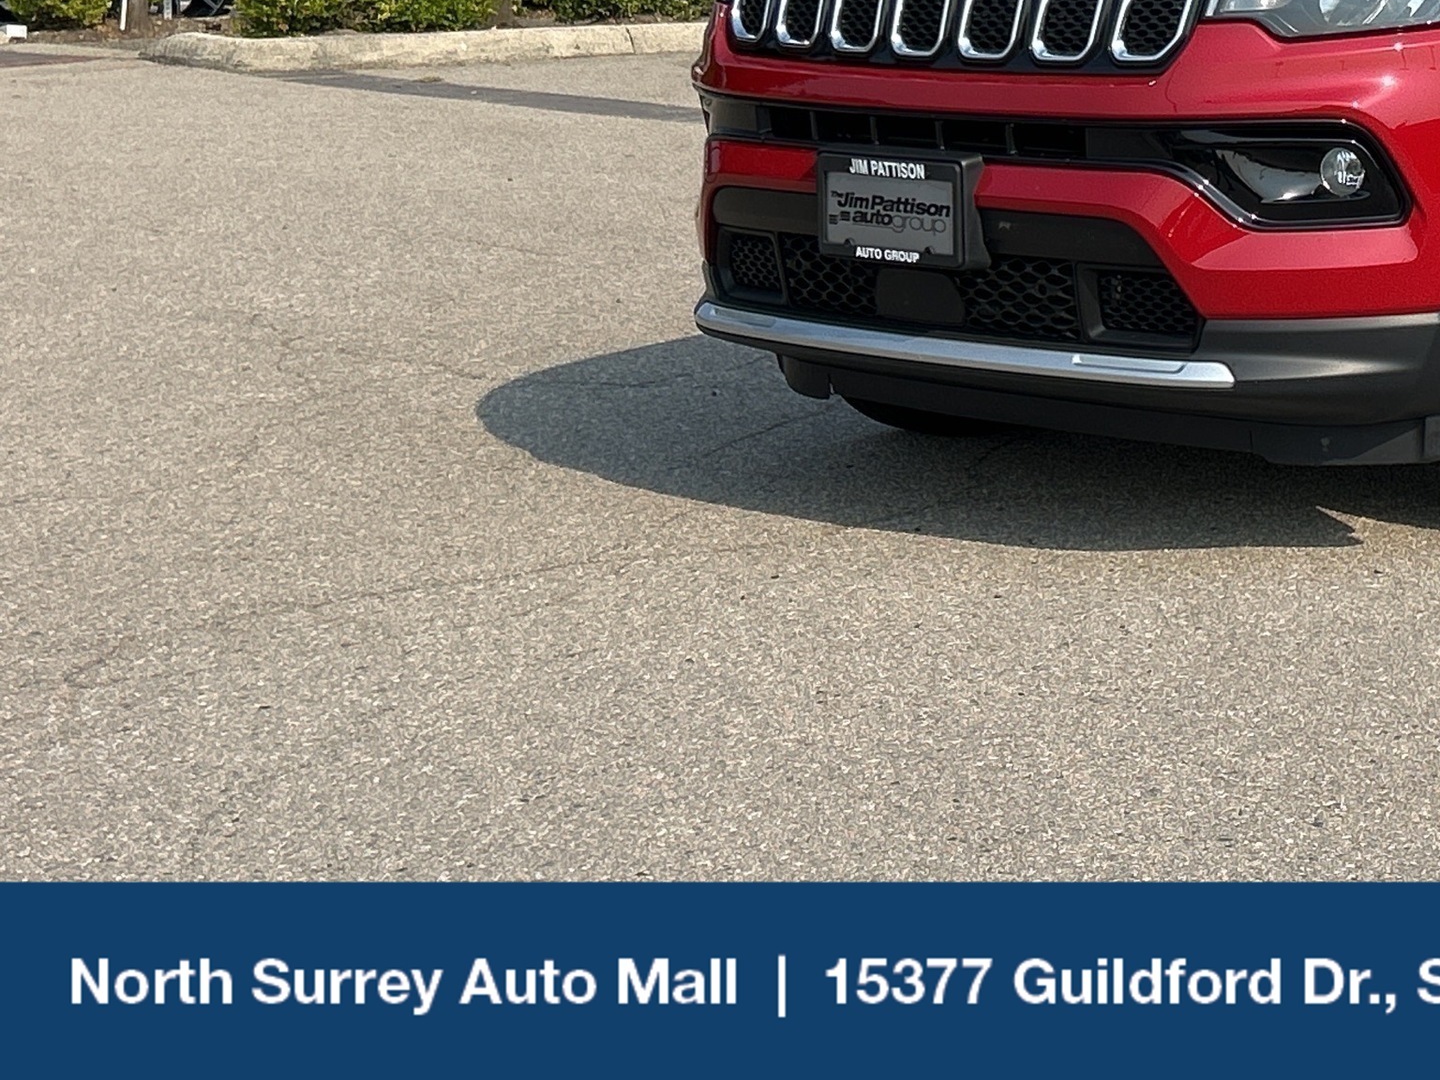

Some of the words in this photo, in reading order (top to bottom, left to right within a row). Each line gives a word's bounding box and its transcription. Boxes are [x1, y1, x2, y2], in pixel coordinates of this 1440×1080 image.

[849, 158, 869, 175] JIM
[870, 160, 926, 179] PATTISON
[837, 192, 870, 210] Jim
[870, 195, 951, 217] Pattison
[856, 246, 881, 259] AUTO
[884, 249, 920, 263] GROUP
